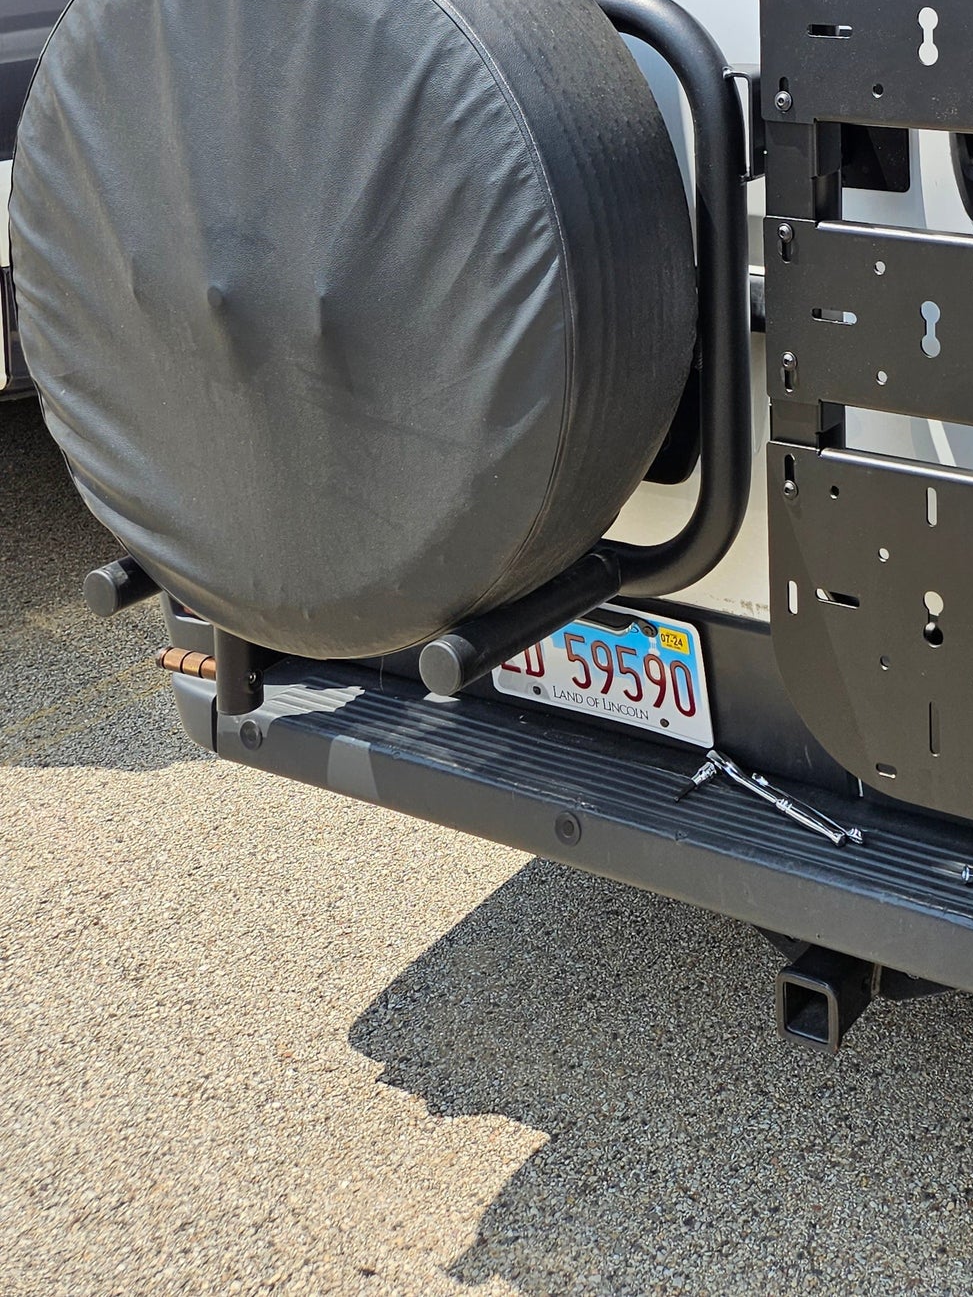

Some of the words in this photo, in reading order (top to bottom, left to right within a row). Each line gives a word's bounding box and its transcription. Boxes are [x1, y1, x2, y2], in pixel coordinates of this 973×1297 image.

[660, 633, 683, 647] 07-24
[563, 632, 696, 717] 59590
[552, 685, 584, 704] LAND
[586, 696, 601, 708] OF
[602, 697, 649, 720] LINCOLN
